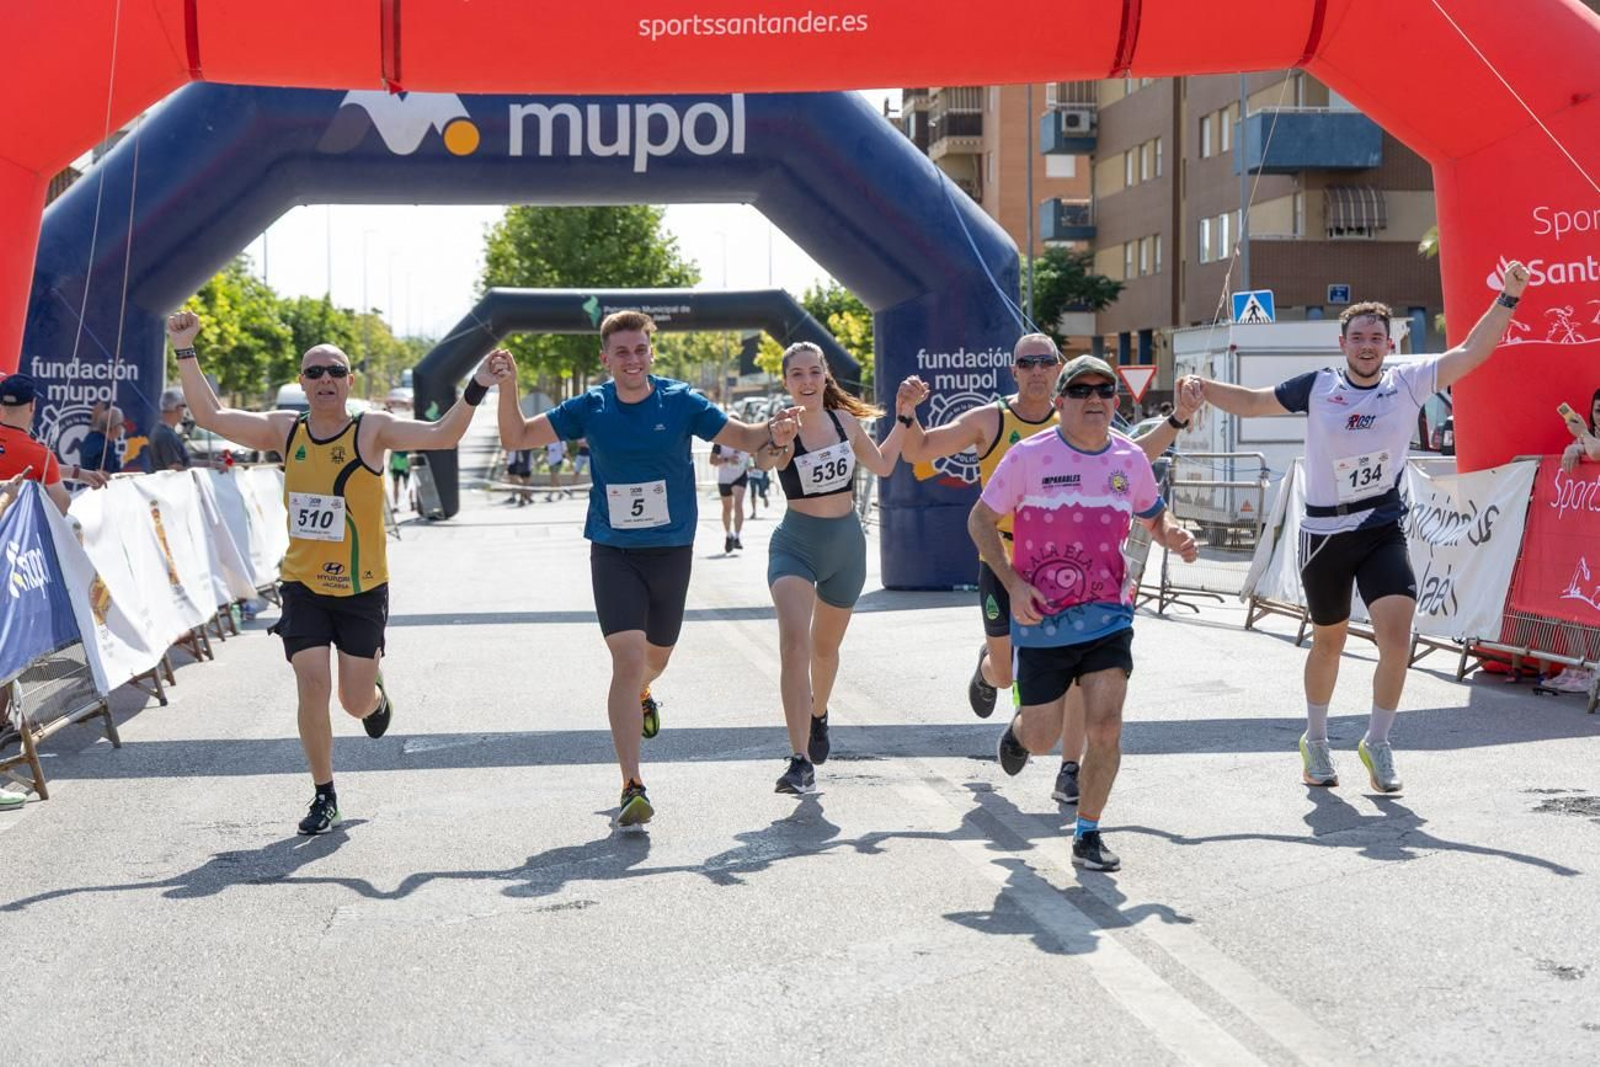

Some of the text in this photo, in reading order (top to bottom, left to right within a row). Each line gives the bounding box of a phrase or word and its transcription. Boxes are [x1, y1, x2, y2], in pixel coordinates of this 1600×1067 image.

[639, 10, 868, 41] sportssantander.es
[509, 93, 745, 172] mupol
[1527, 255, 1600, 286] Sant
[31, 356, 138, 380] fundación
[917, 347, 1012, 369] fundación
[935, 368, 997, 393] mupol
[48, 381, 117, 406] mupol
[812, 457, 847, 483] 536
[954, 453, 980, 464] POLIC
[1349, 463, 1382, 487] 134
[298, 508, 334, 529] 510
[631, 498, 645, 517] 5
